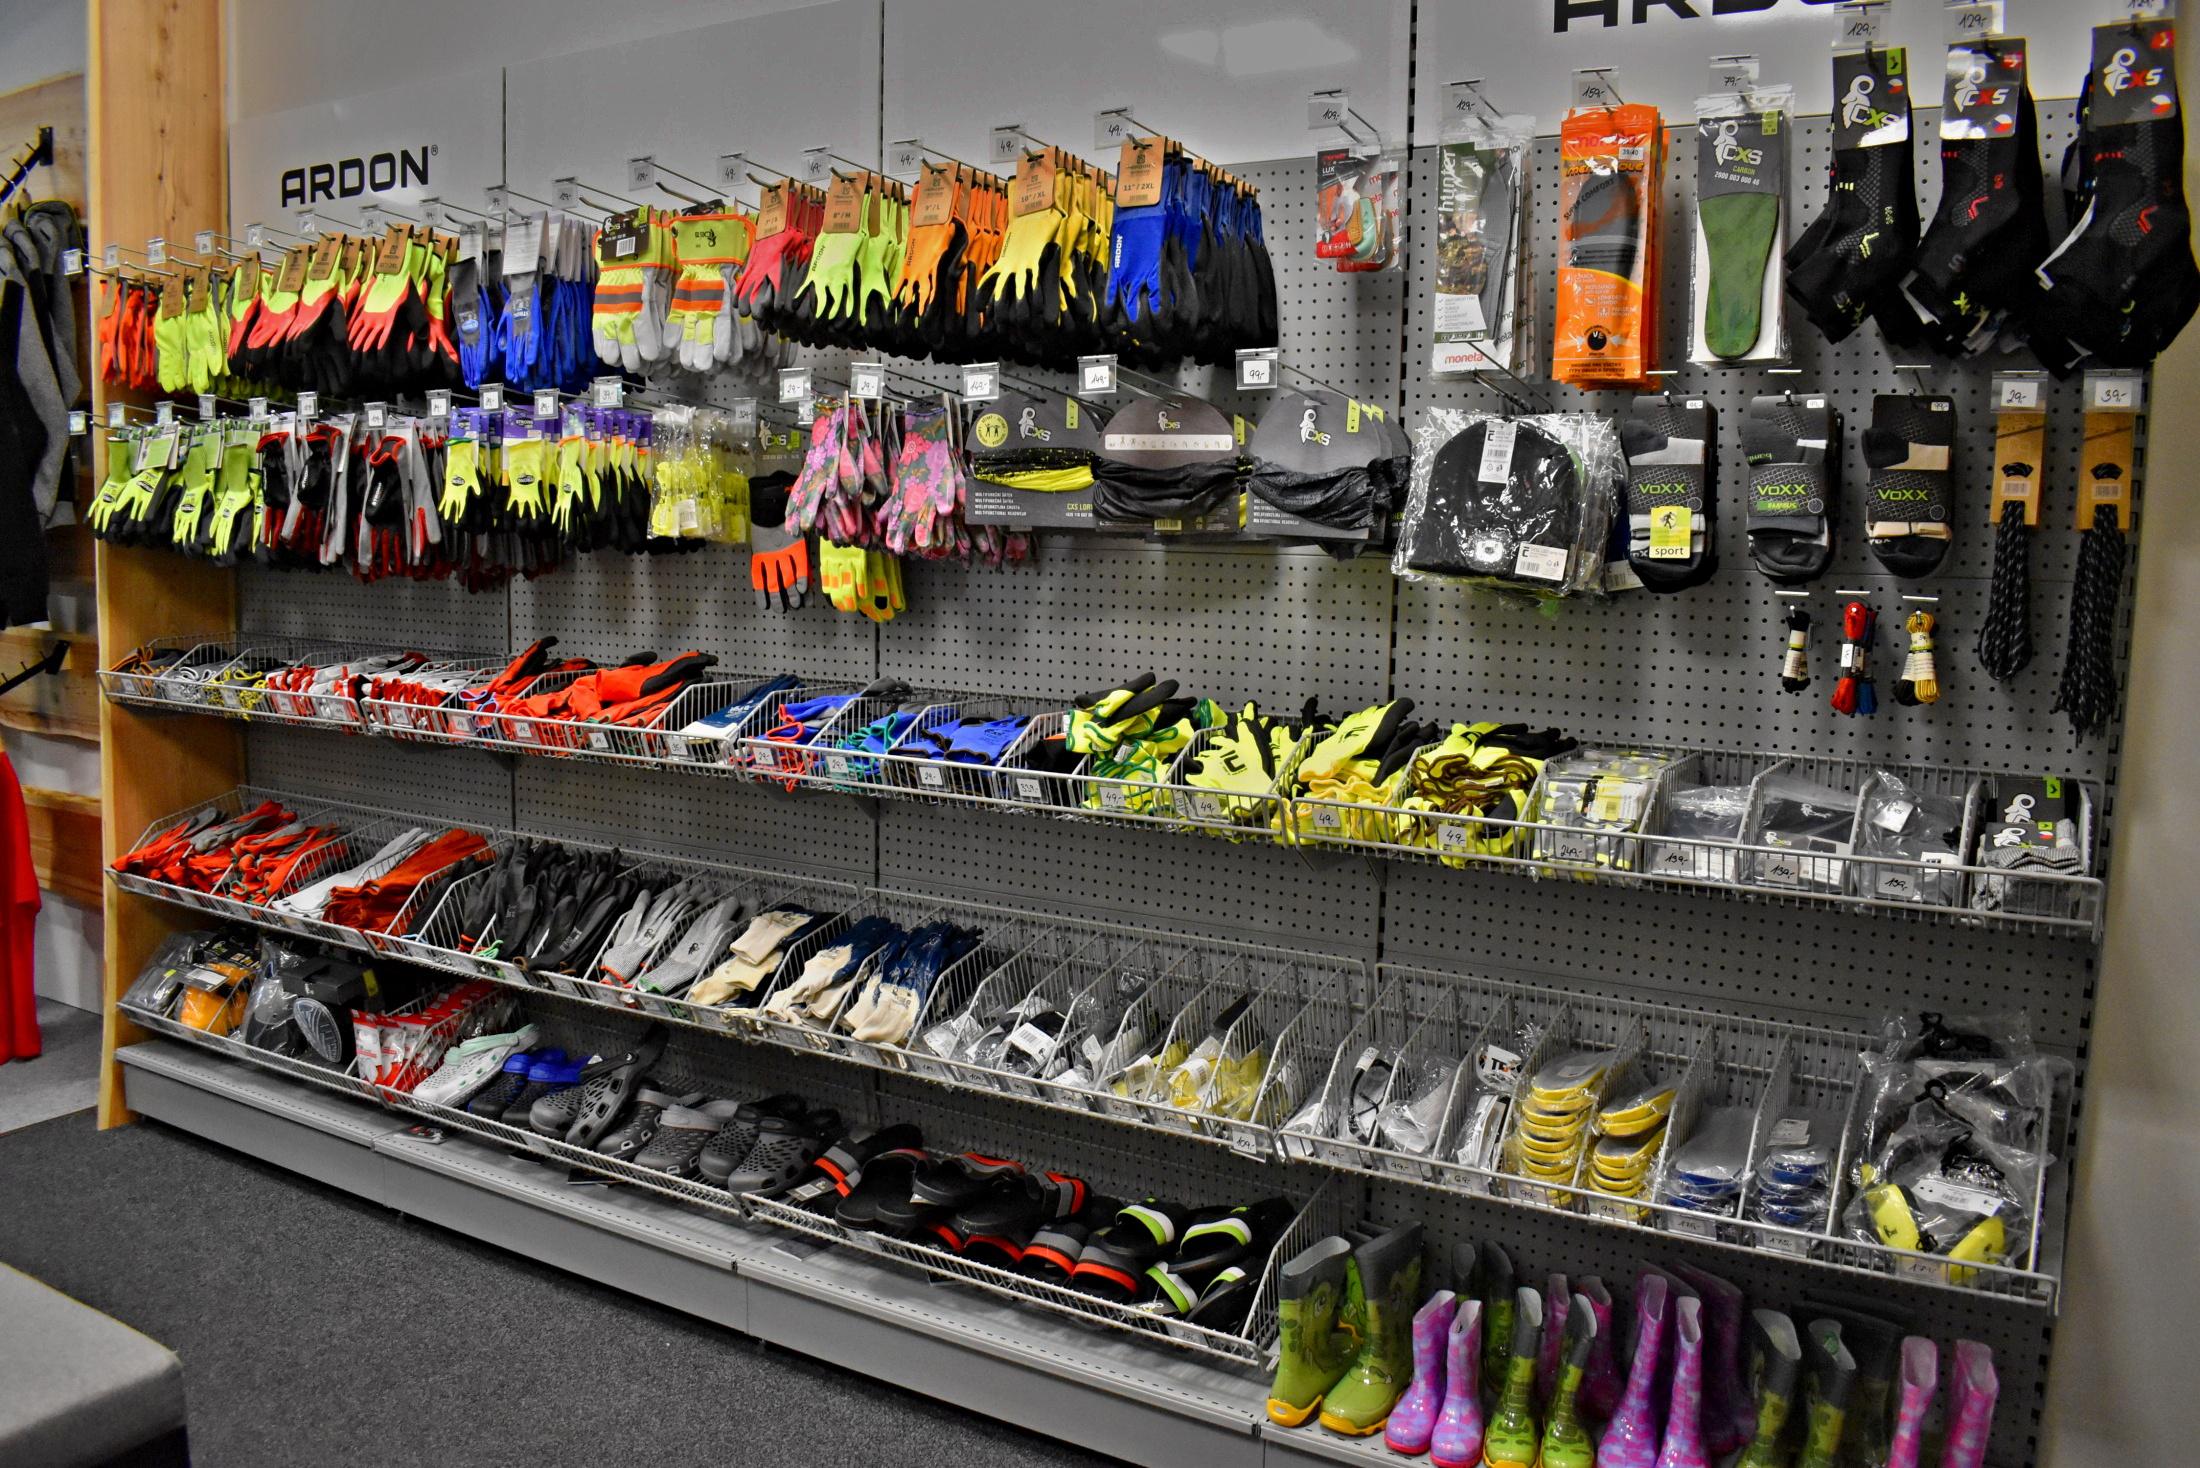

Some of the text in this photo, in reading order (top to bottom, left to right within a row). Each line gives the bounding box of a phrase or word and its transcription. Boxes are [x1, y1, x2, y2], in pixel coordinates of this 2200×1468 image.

[1959, 13, 1987, 29] 129,-
[1847, 22, 1877, 37] 129,-
[2114, 67, 2163, 91] CXS
[1962, 88, 2009, 107] CXS
[1722, 145, 1764, 165] CXS
[1581, 178, 1615, 202] COMFORT
[1445, 352, 1485, 365] moneta
[2101, 389, 2128, 404] 39,-
[765, 434, 788, 446] CXS
[1025, 424, 1052, 442] CXS
[1305, 428, 1332, 446] CXS
[1655, 547, 1684, 557] sport
[1105, 791, 1122, 804] 49,-
[1200, 801, 1216, 813] 49,-
[1319, 814, 1334, 826] 49,-
[1446, 829, 1465, 844] 49,-
[1561, 844, 1583, 858] 249,-
[1664, 852, 1688, 866] 139,-
[1771, 864, 1795, 879] 139,-
[1885, 877, 1909, 892] 139,-
